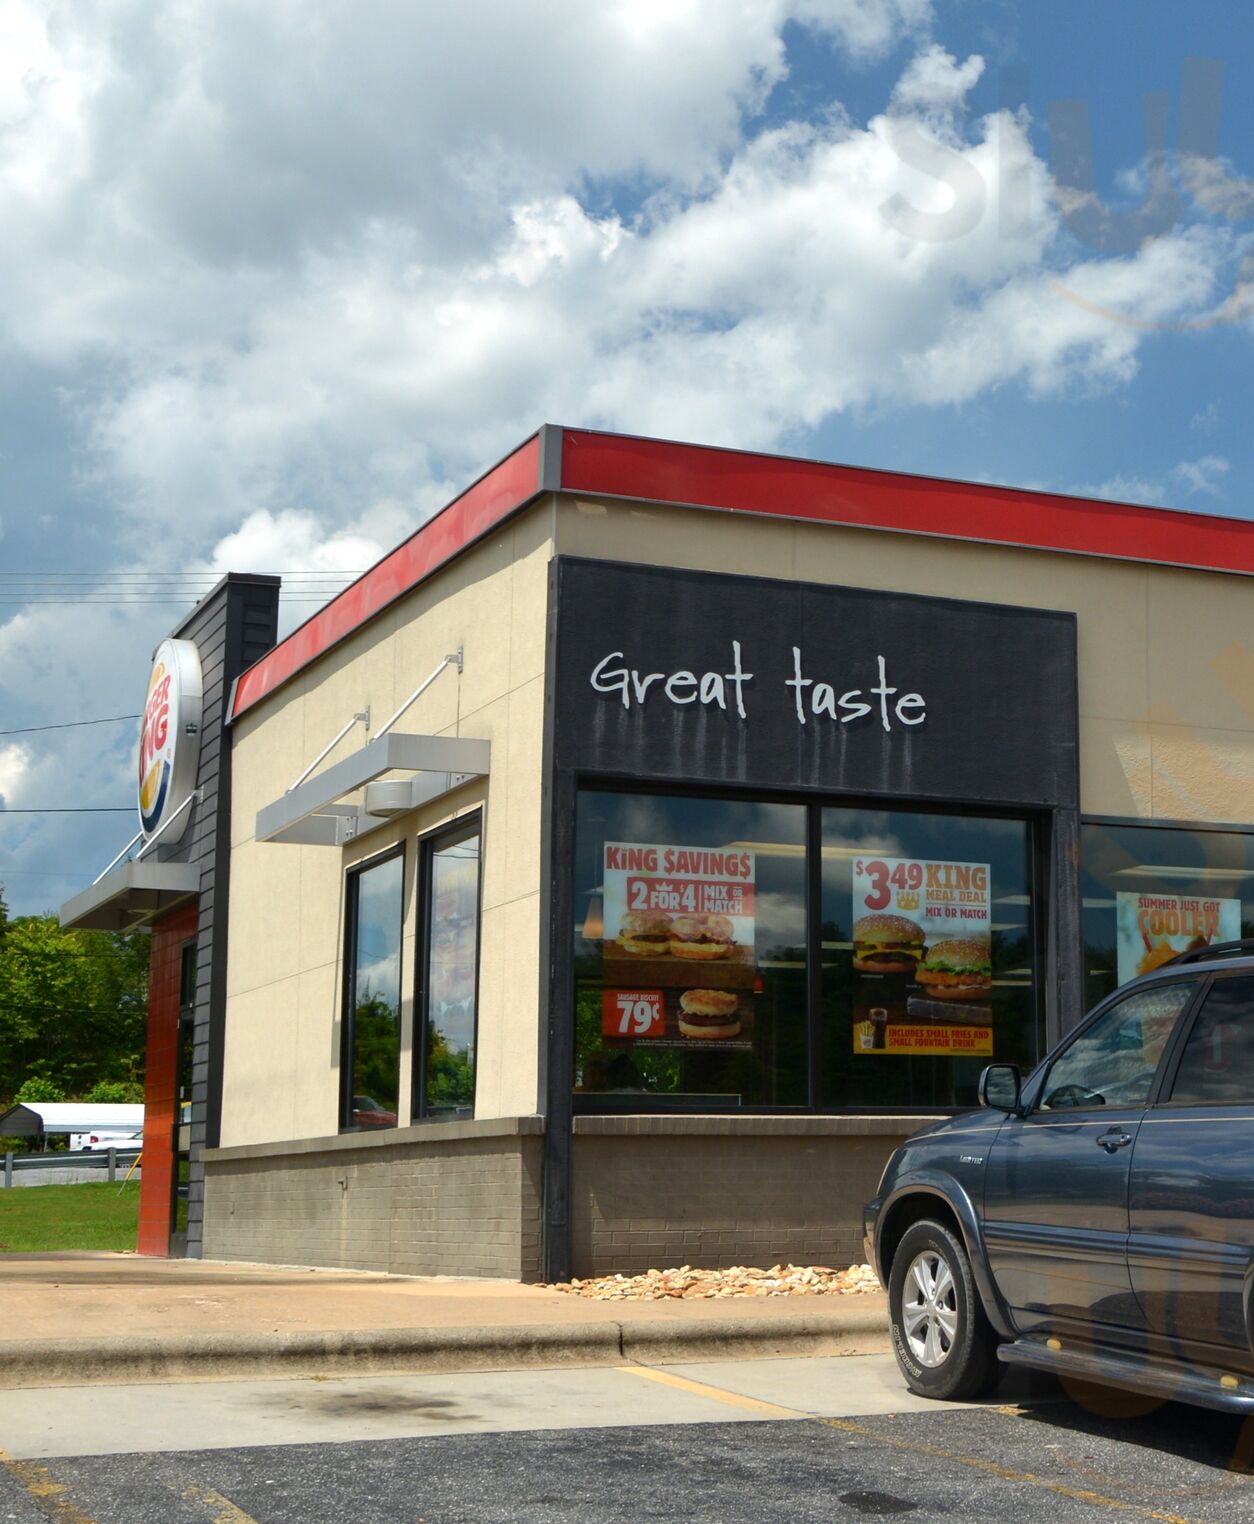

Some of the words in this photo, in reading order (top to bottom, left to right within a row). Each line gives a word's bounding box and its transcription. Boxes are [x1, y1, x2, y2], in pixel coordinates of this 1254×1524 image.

[590, 640, 754, 719] Great
[785, 646, 926, 732] taste
[664, 848, 751, 880] $AVING$
[925, 863, 987, 891] KING
[631, 881, 648, 910] 2
[650, 891, 680, 910] FOR
[680, 884, 696, 912] $4
[704, 885, 728, 899] MIX
[732, 888, 743, 897] OR
[925, 889, 956, 902] MEAL
[959, 890, 987, 903] DEAL
[704, 900, 743, 913] MATCH
[925, 907, 942, 917] MIX
[945, 908, 957, 918] OR
[959, 908, 987, 919] MATCH
[1138, 897, 1177, 910] SUMMER
[1180, 900, 1199, 912] JUST
[1203, 901, 1220, 913] GOT
[1138, 910, 1220, 936] COOLER
[617, 1000, 660, 1034] 79¢
[888, 1029, 924, 1038] INCLUDES
[926, 1029, 949, 1038] SMALL
[951, 1030, 972, 1038] FRIES
[974, 1031, 989, 1039] AND
[888, 1038, 913, 1046] SMALL
[914, 1038, 950, 1047] FOUNTAIN
[952, 1039, 977, 1048] DRINK
